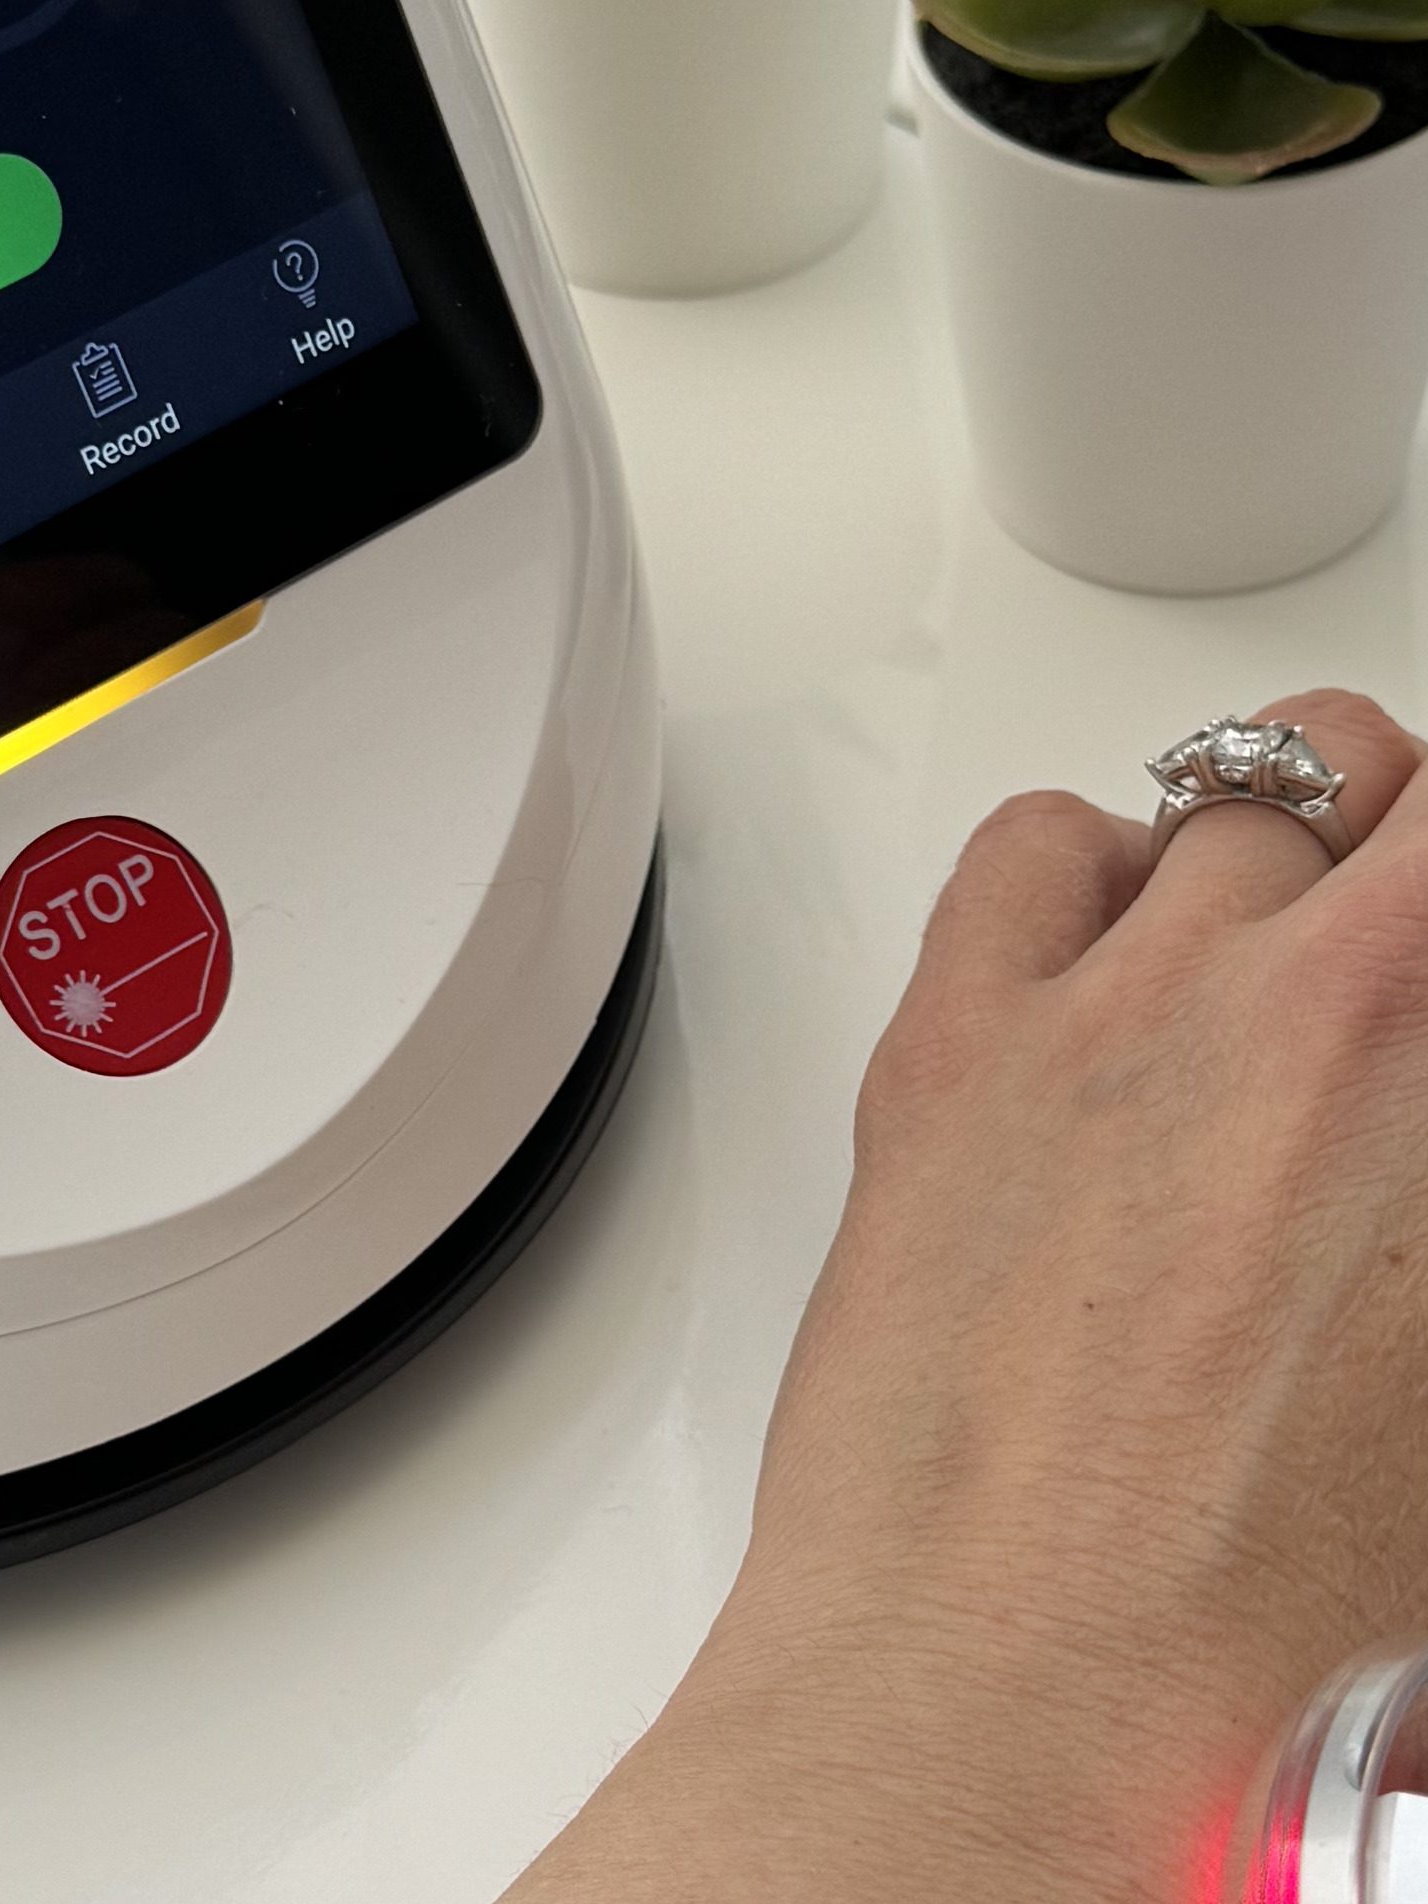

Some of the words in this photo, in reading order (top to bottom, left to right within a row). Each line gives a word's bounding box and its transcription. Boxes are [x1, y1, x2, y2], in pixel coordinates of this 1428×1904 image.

[291, 318, 355, 364] Help
[80, 403, 181, 476] Record
[18, 854, 155, 960] STOP
